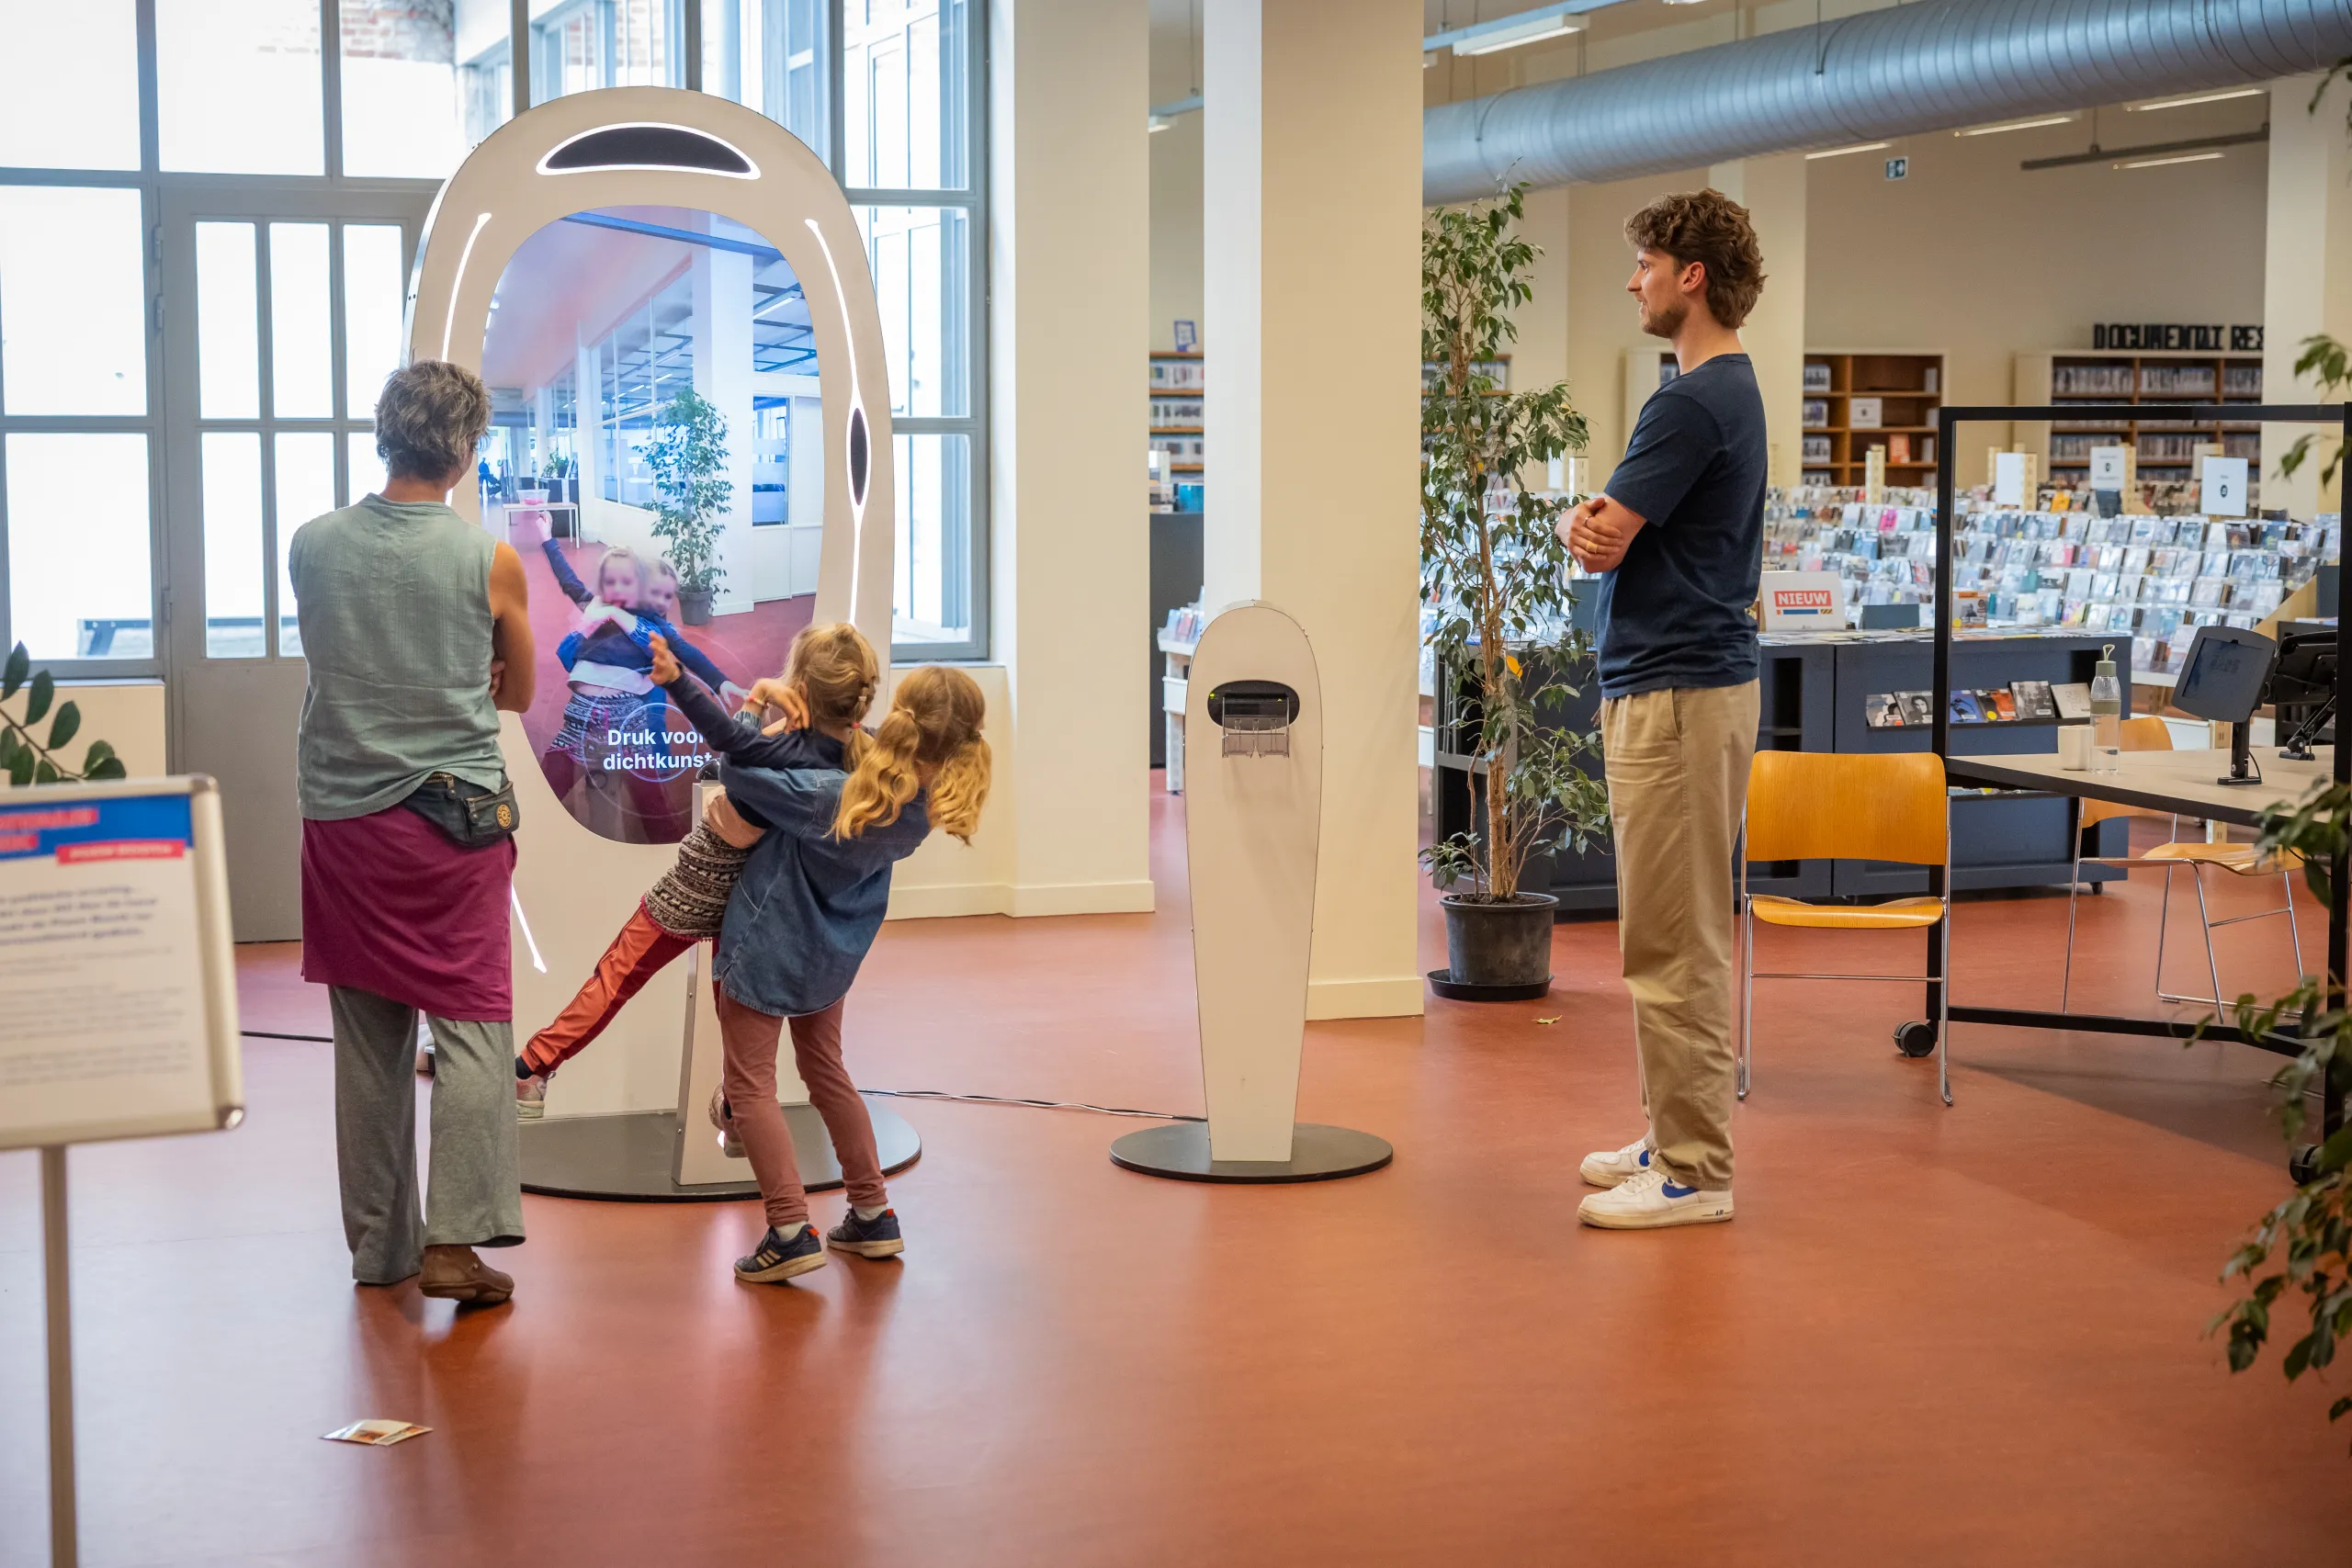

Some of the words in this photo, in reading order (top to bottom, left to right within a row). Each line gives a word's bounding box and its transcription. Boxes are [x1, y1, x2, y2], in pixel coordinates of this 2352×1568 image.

[1778, 592, 1828, 605] NIEUW
[607, 728, 657, 746] Druk
[603, 752, 713, 770] dichtkunst
